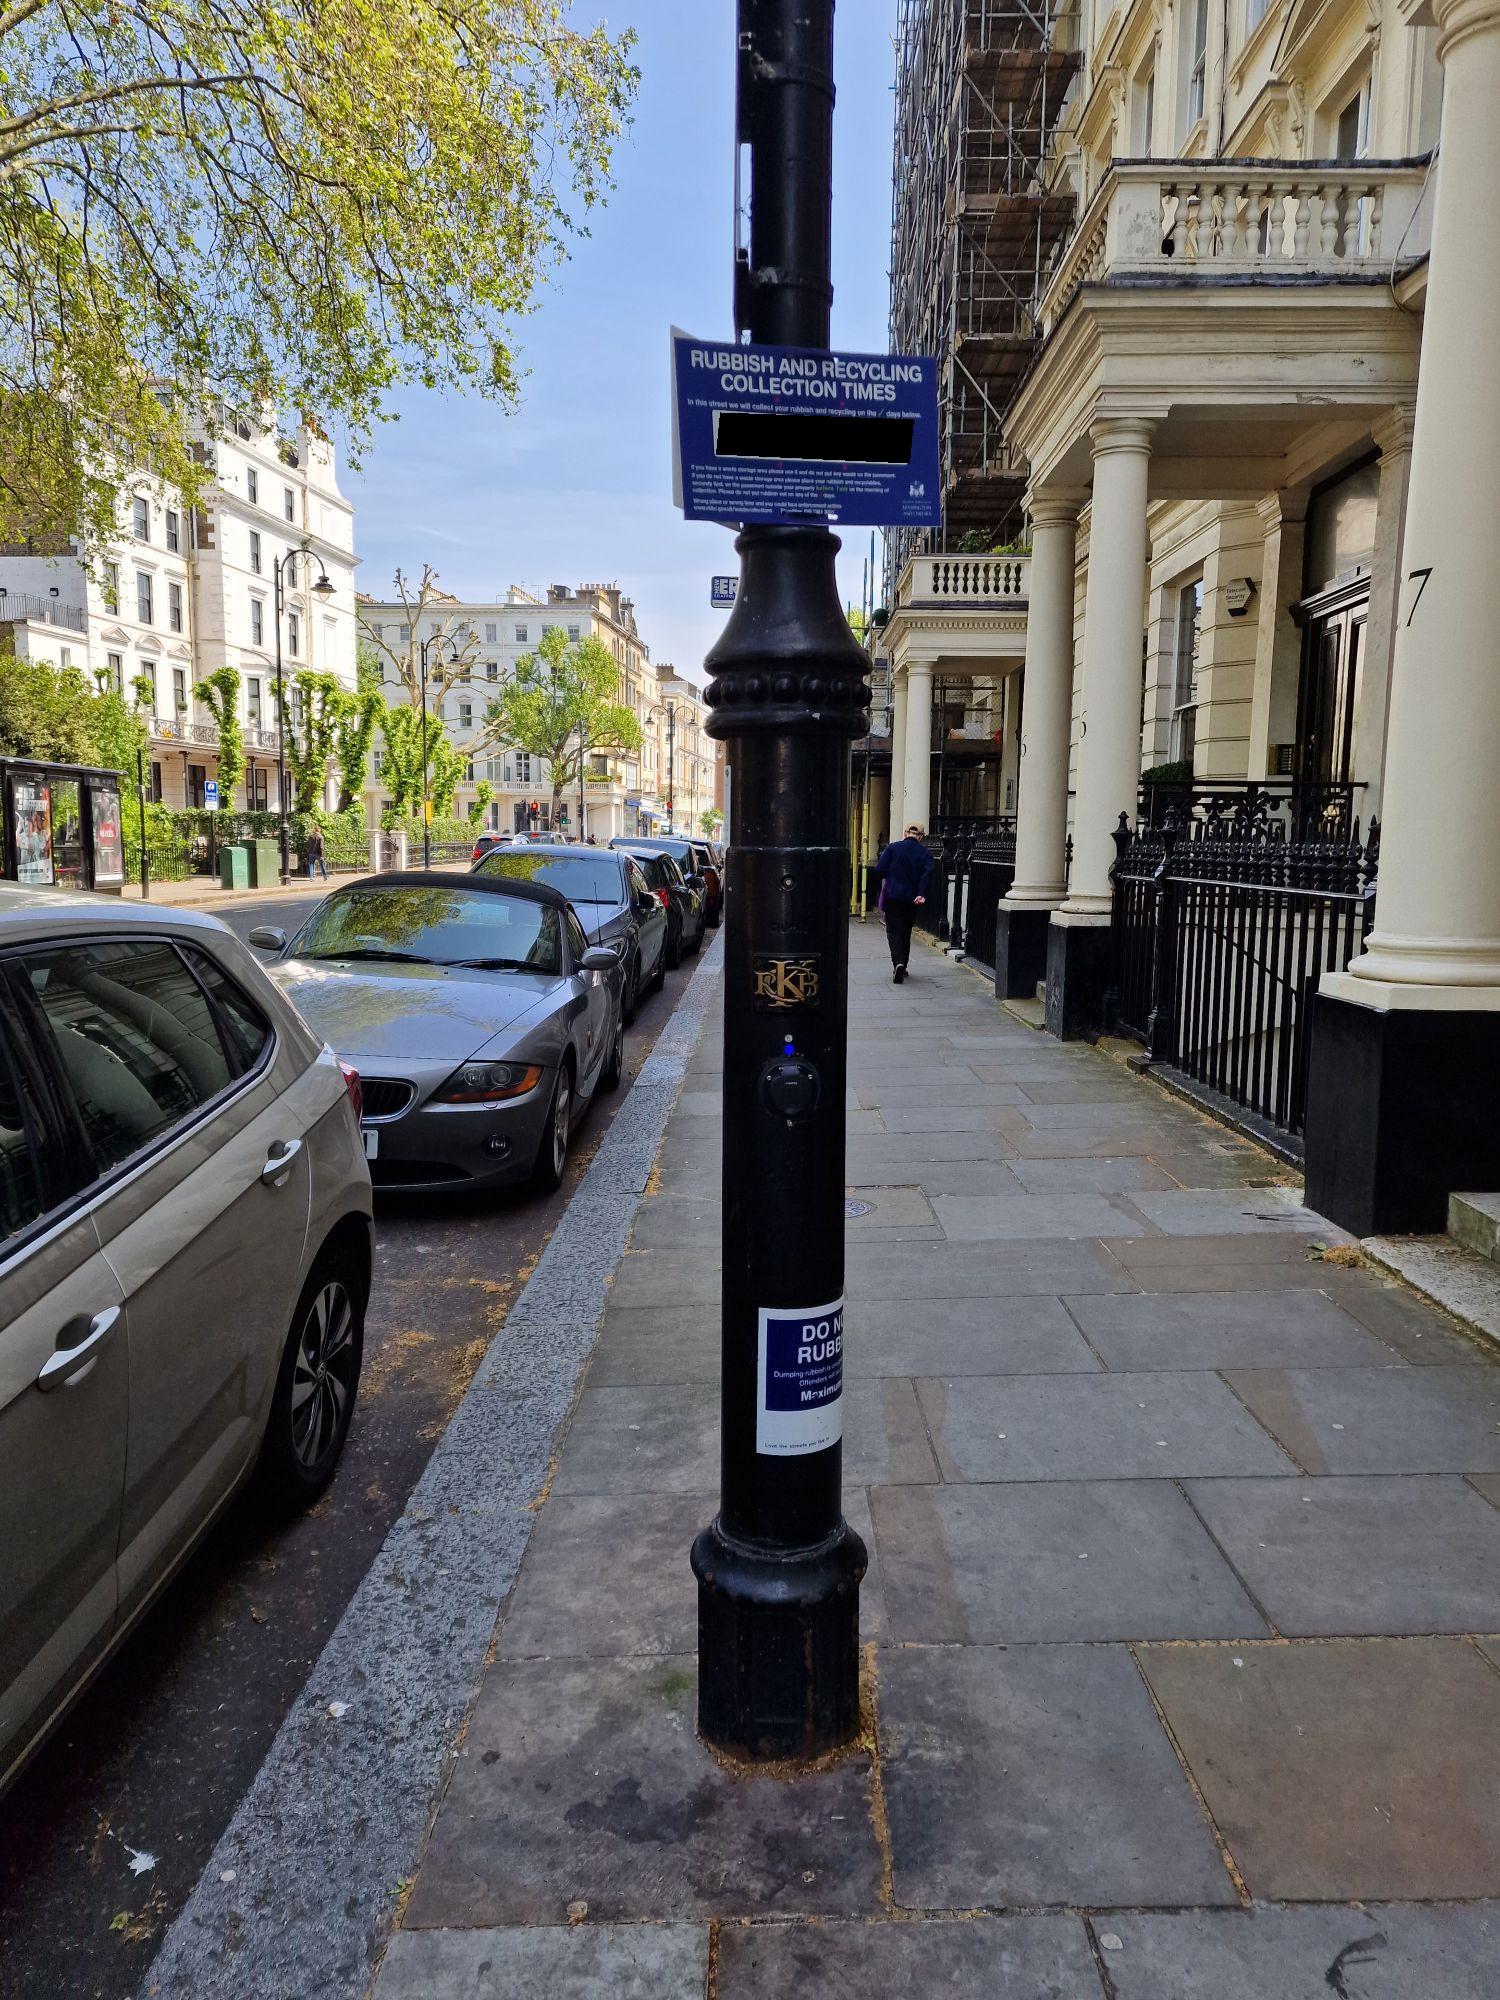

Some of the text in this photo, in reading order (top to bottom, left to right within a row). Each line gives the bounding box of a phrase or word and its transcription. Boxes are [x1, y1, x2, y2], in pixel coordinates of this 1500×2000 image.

[690, 350, 922, 382] RUBBISH AND RECYCLING
[720, 374, 896, 401] COLLECTION TIMES
[1406, 568, 1433, 626] 7
[802, 1322, 829, 1342] DO
